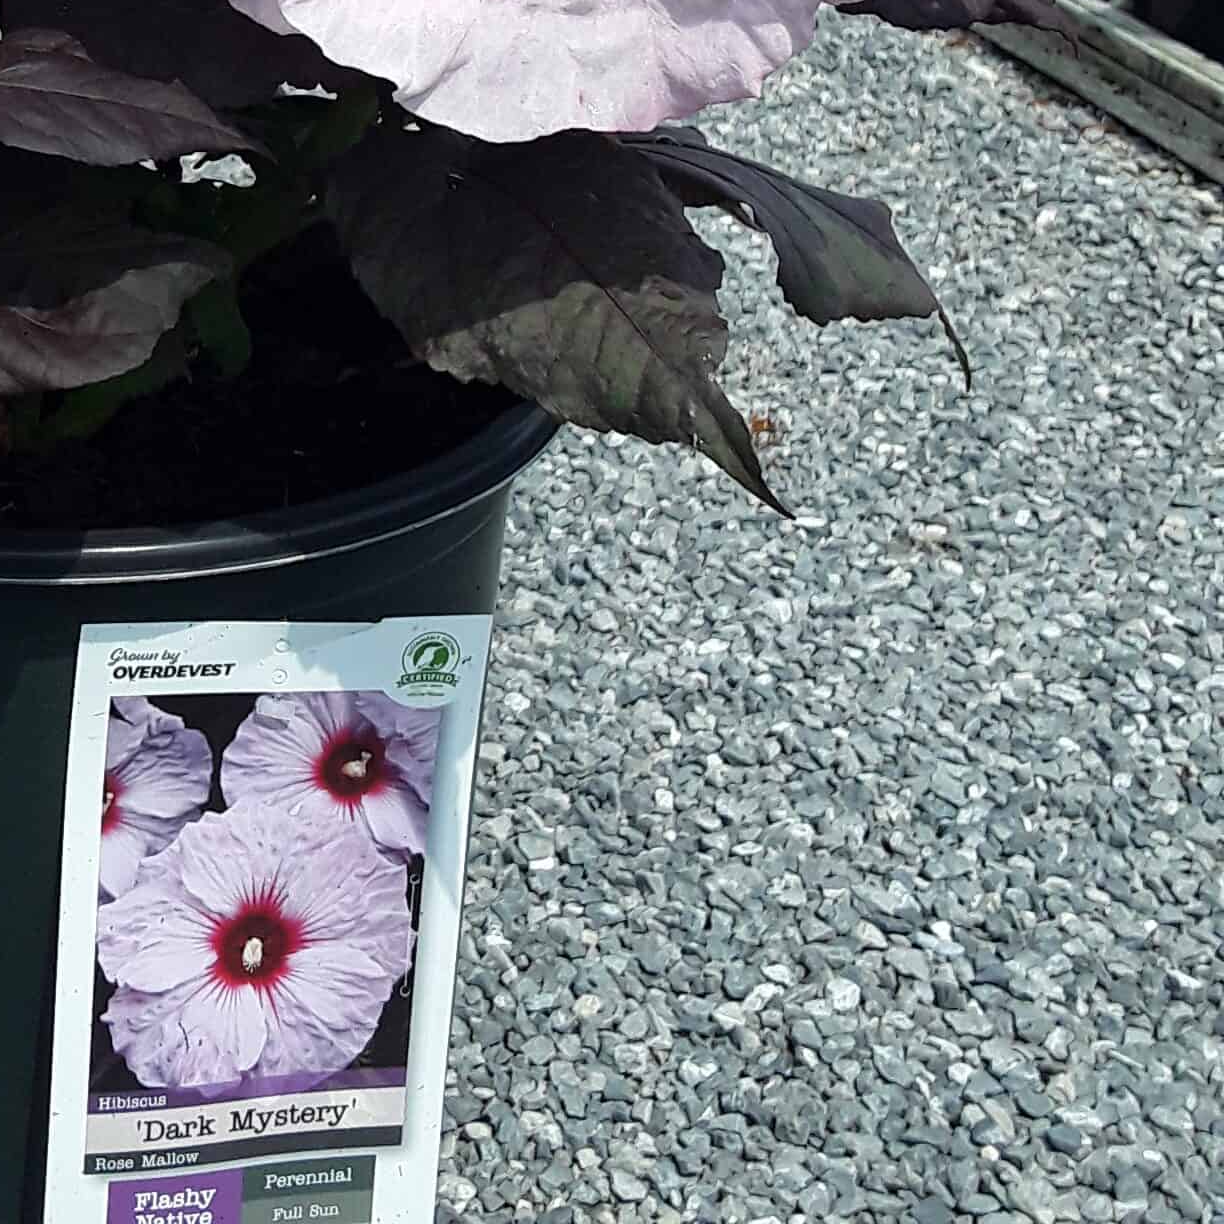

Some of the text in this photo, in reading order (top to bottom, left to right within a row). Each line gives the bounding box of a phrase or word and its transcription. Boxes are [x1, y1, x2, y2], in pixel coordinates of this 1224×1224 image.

[108, 647, 180, 667] Grown by
[112, 662, 236, 680] OVERDEVEST
[402, 672, 453, 684] CERTIFIED
[97, 1093, 167, 1111] Hibiscus
[136, 1098, 358, 1143] 'Dark Mystery'
[94, 1150, 200, 1172] Rose Mallow
[264, 1167, 352, 1190] Perennial
[134, 1187, 217, 1211] Flashy
[272, 1203, 339, 1222] Full Sun
